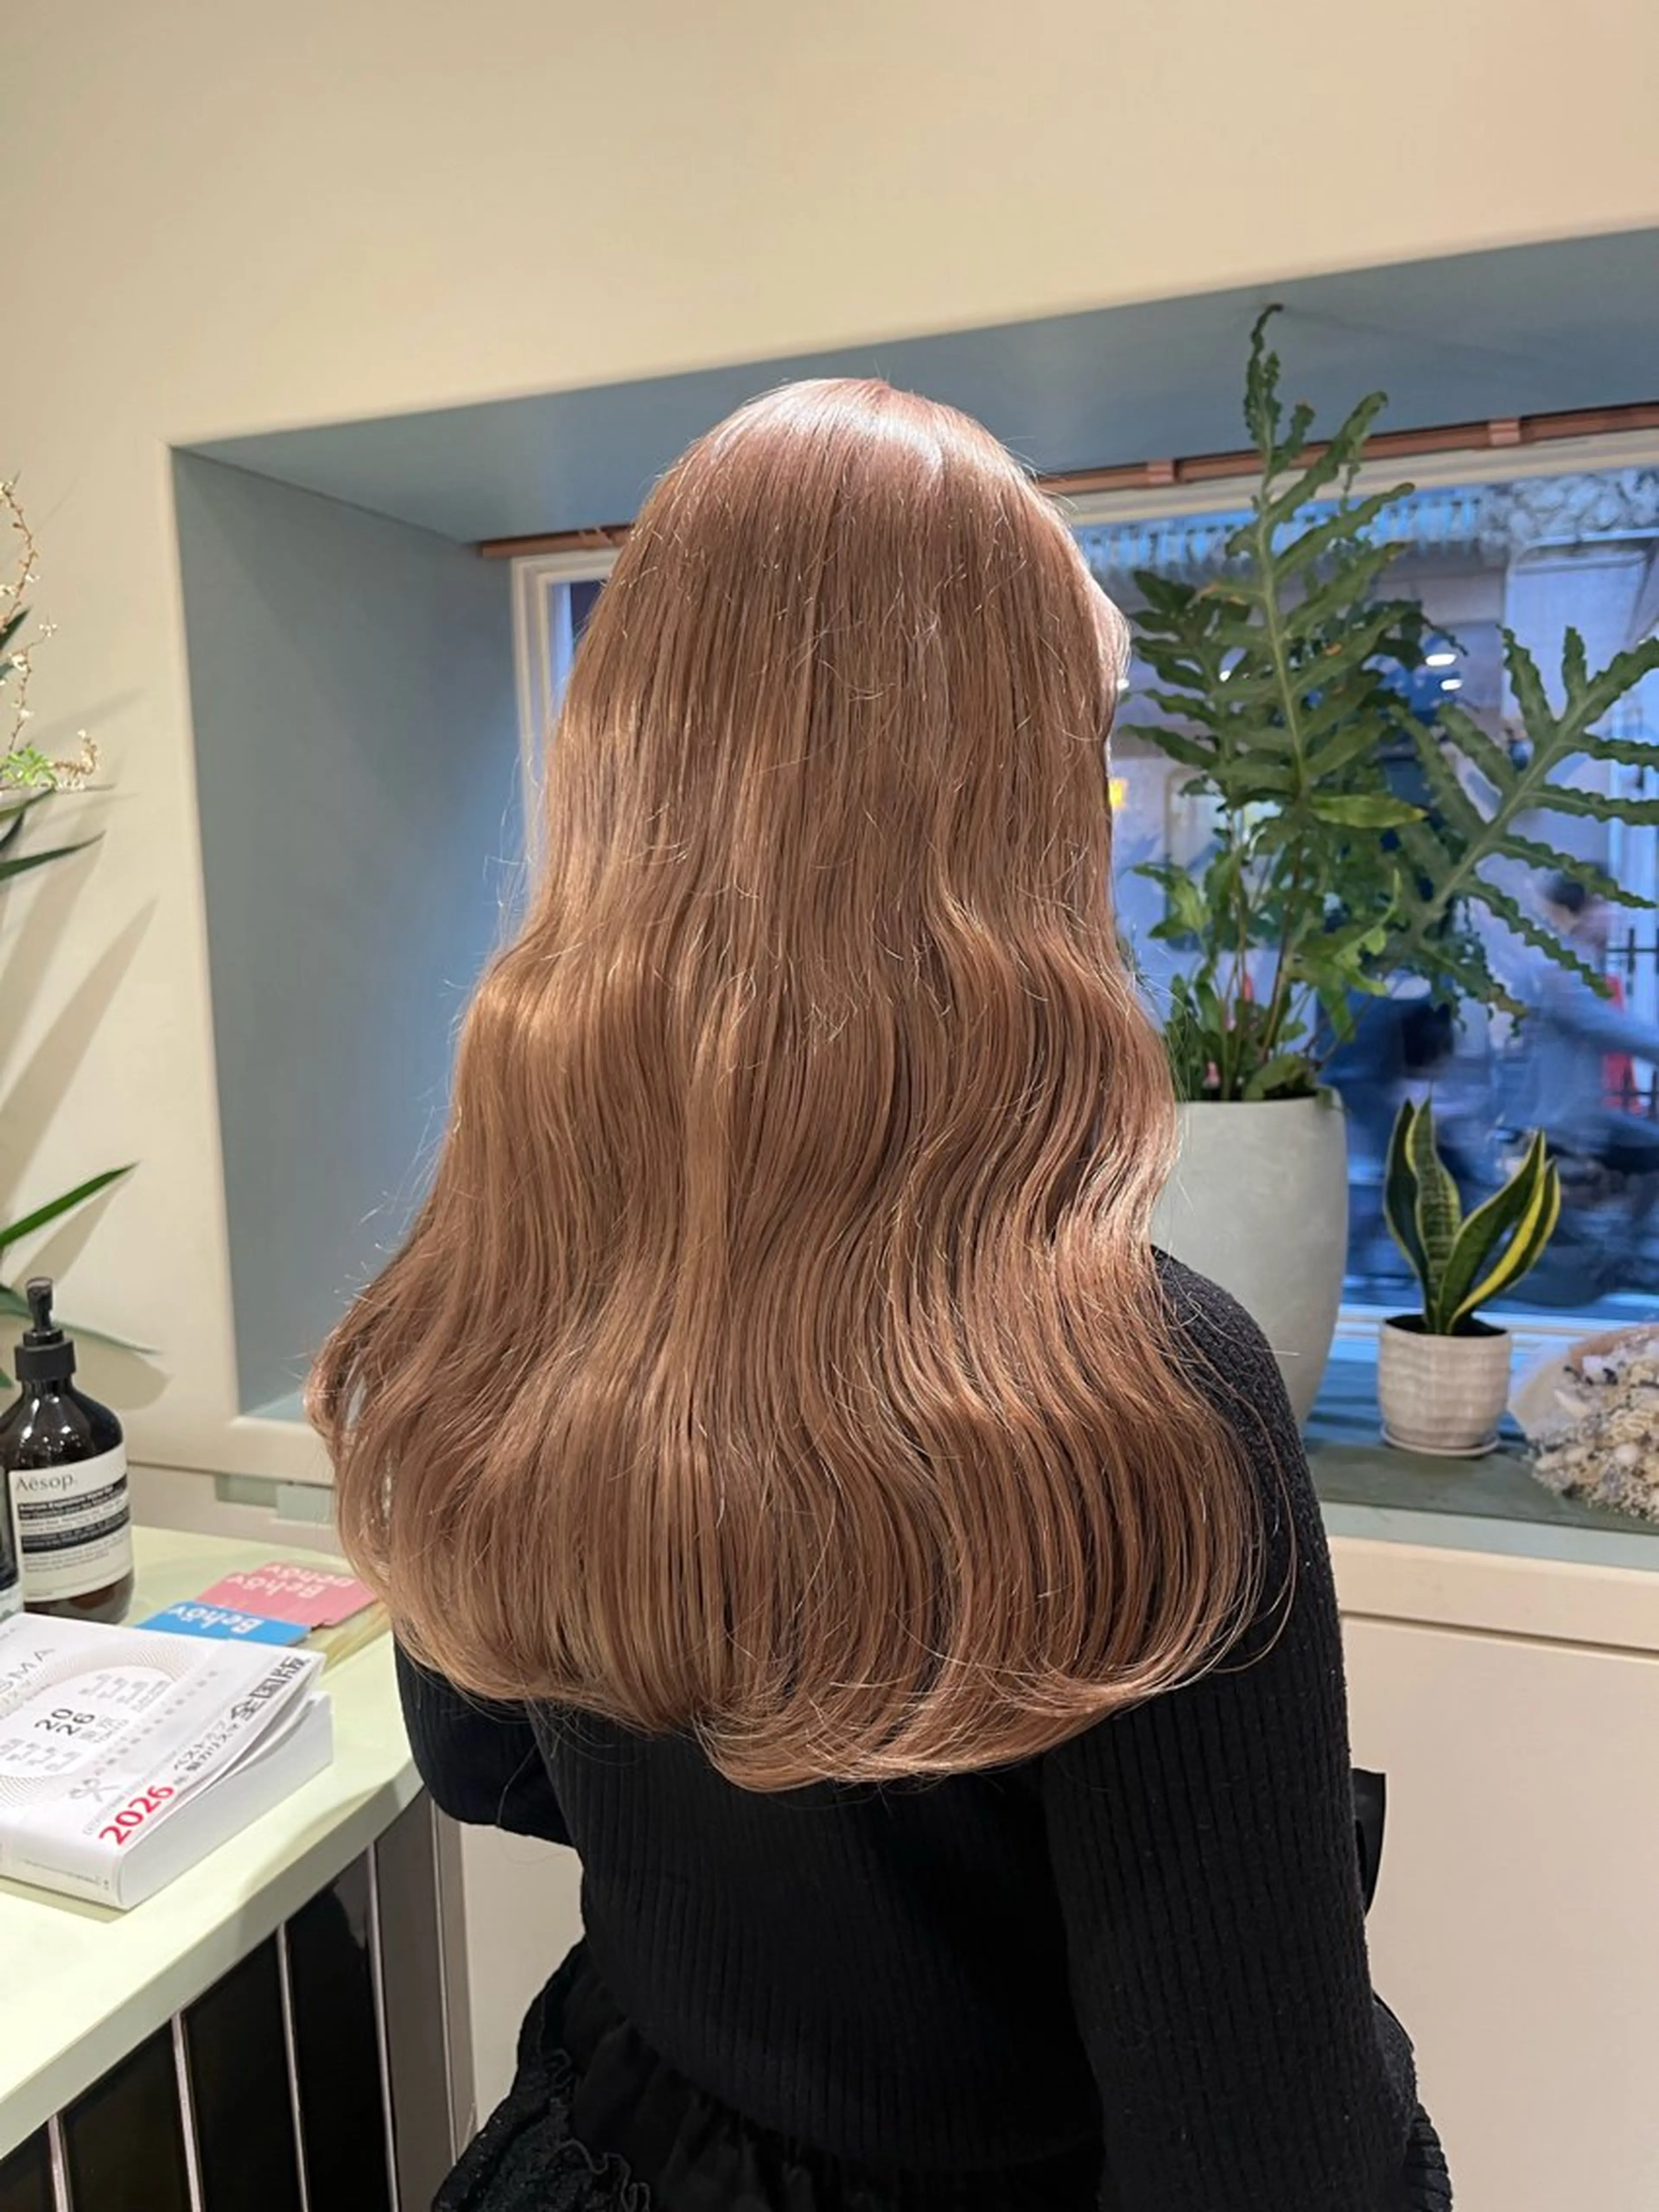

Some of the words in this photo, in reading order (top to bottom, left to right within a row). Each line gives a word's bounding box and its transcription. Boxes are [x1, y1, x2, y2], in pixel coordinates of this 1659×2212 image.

[231, 1656, 311, 1722] 全国版
[34, 1708, 74, 1731] 20
[55, 1712, 96, 1736] 26
[99, 1785, 175, 1845] 2026
